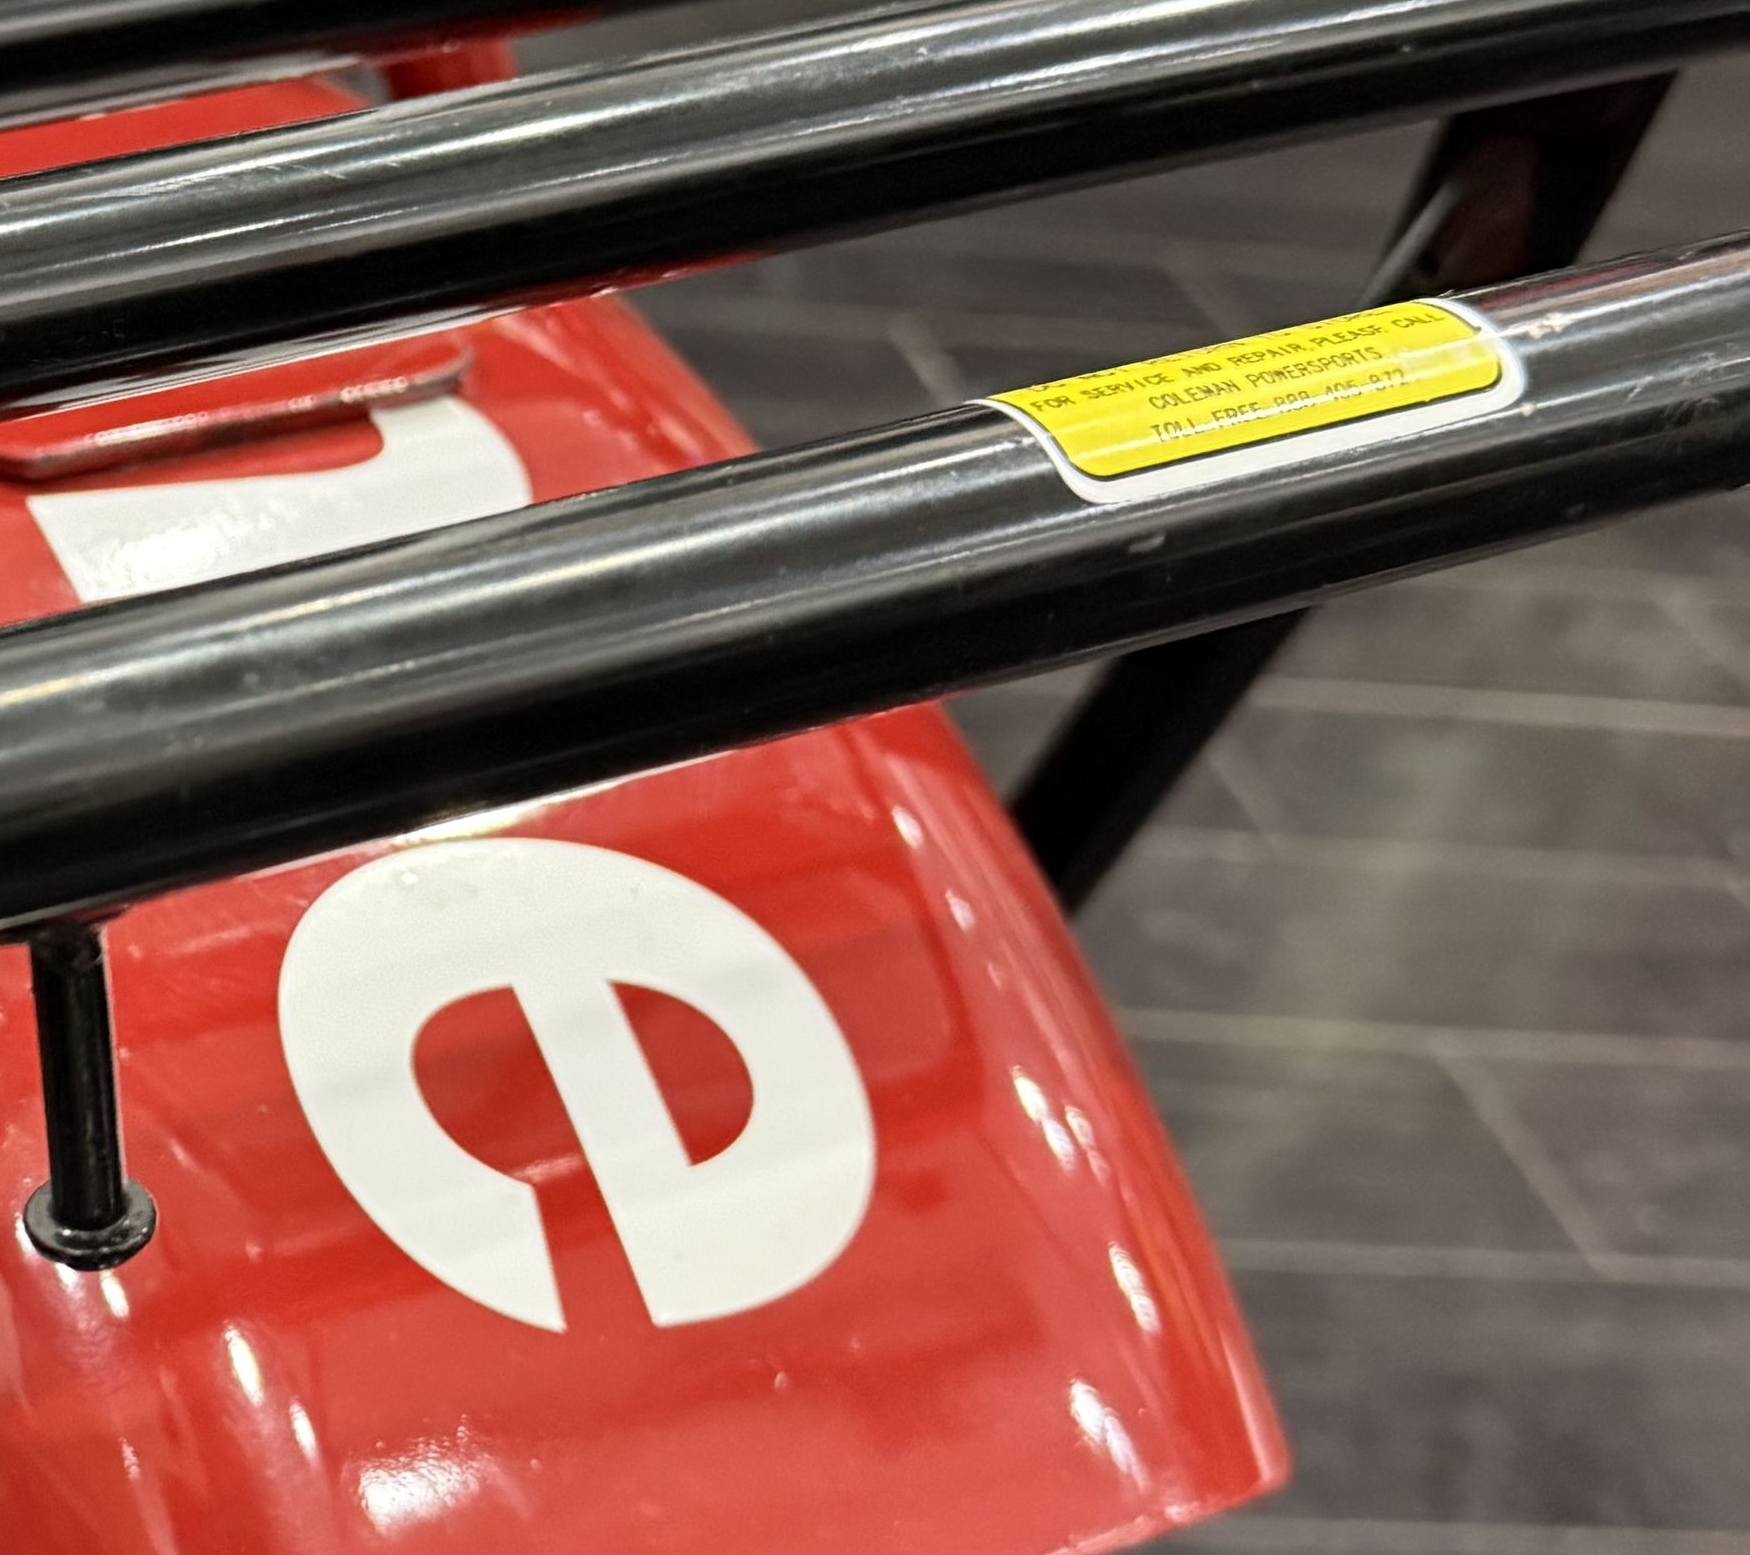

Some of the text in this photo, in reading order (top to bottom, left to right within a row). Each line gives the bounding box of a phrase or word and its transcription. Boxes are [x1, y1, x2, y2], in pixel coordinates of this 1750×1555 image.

[1030, 395, 1077, 413] FOR
[1080, 372, 1174, 400] SERVICE
[1181, 361, 1223, 378] AND
[1392, 313, 1446, 330] CALL
[1148, 379, 1241, 410] COLEMAN
[1245, 346, 1383, 388] POWERSPORTS
